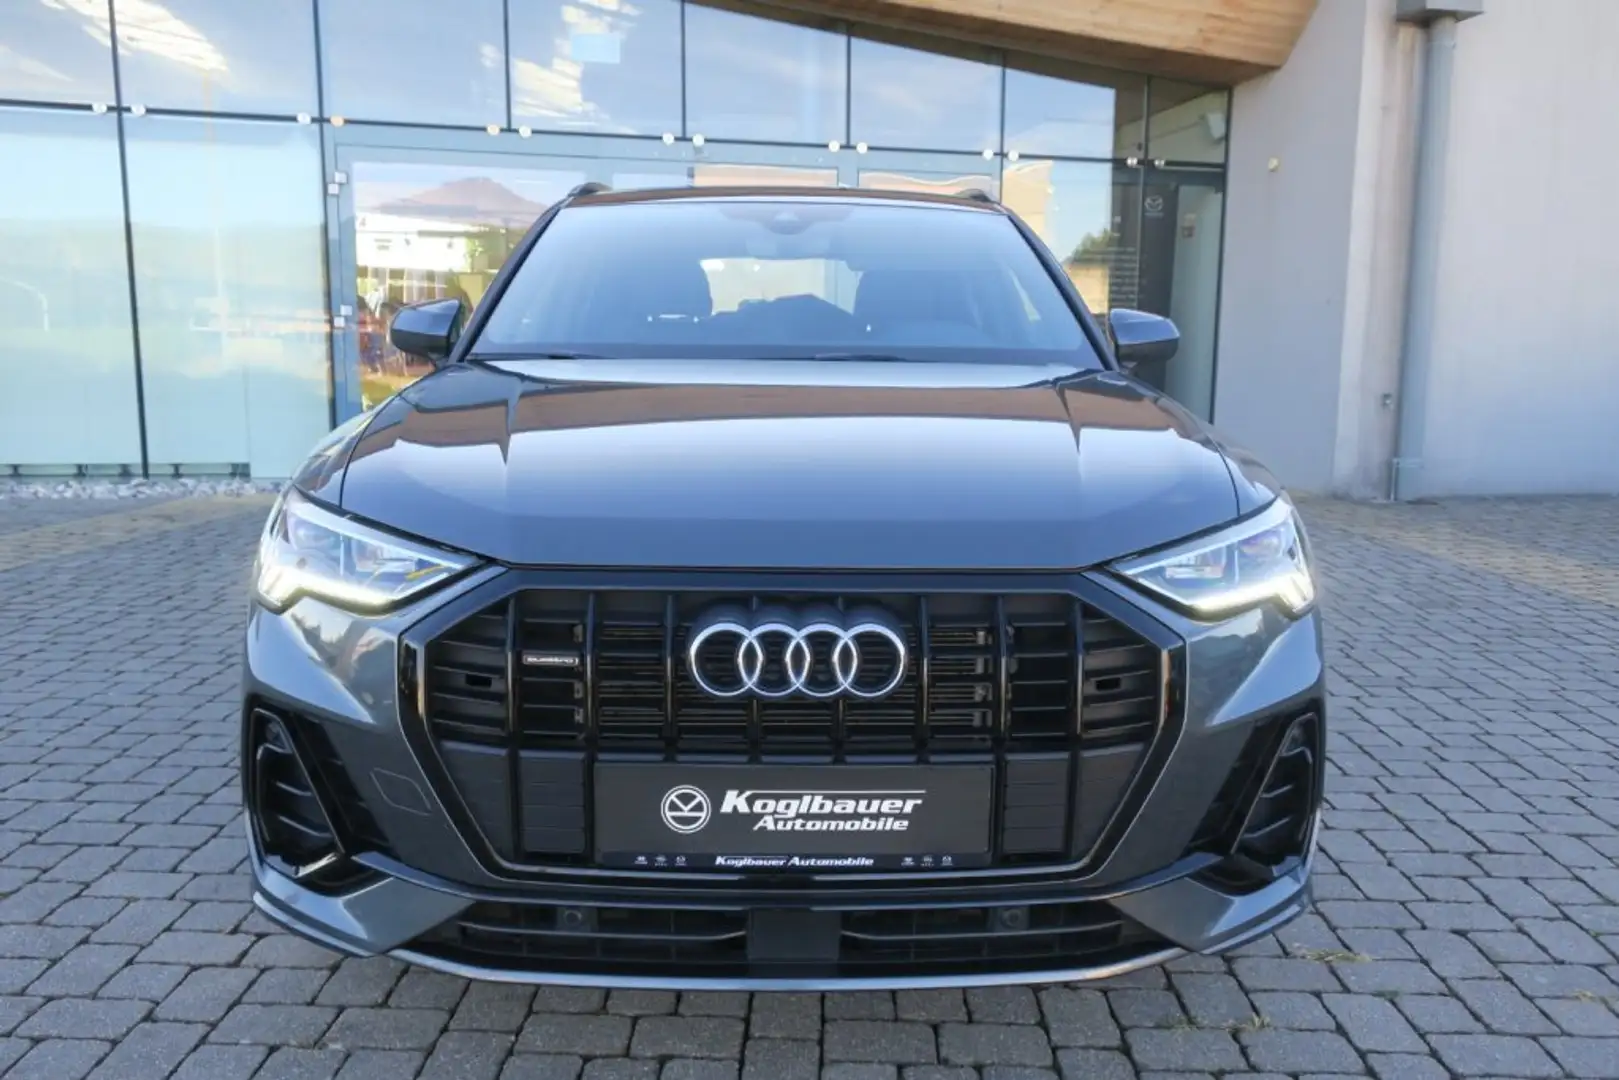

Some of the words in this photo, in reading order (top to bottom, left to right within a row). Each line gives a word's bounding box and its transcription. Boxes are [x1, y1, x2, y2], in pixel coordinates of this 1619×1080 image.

[720, 789, 926, 818] Koglbauer
[753, 815, 909, 831] Automobile
[715, 855, 787, 867] Koglbauer
[787, 856, 874, 867] Automobile
